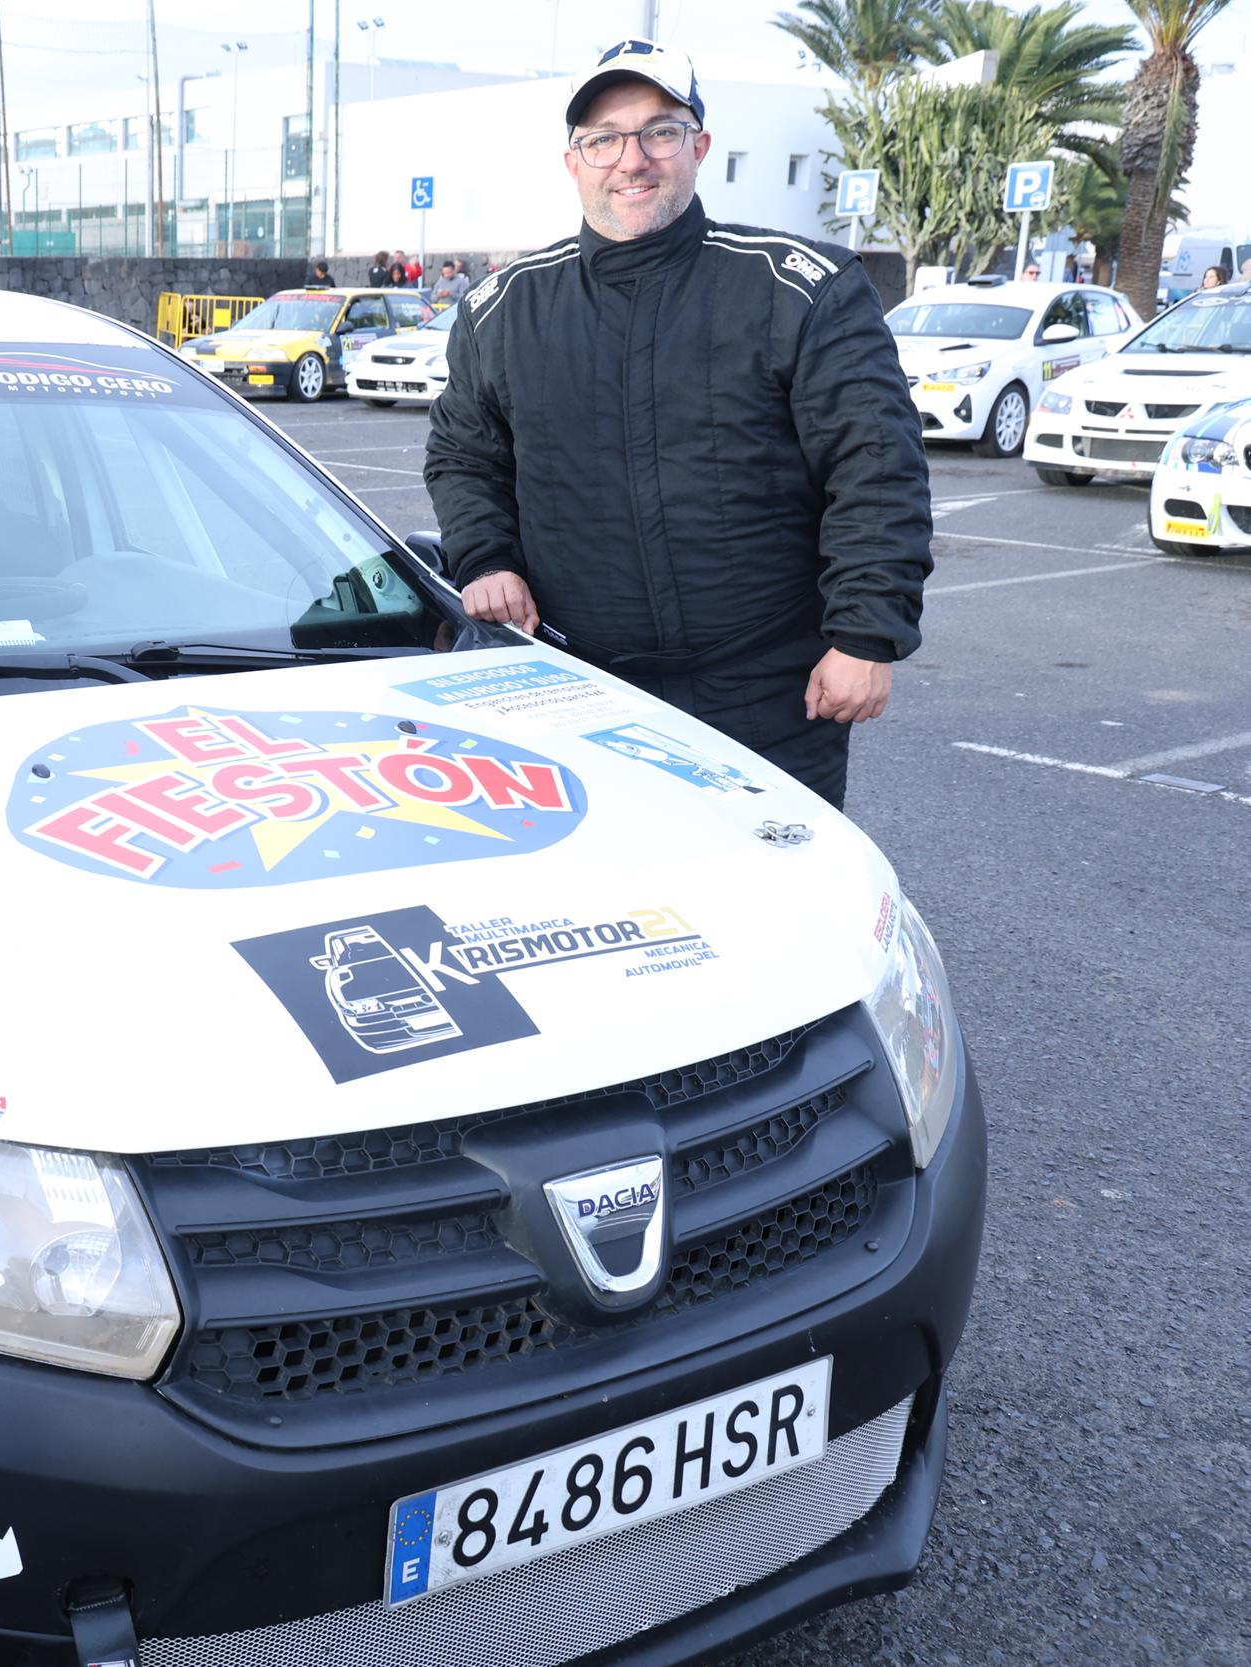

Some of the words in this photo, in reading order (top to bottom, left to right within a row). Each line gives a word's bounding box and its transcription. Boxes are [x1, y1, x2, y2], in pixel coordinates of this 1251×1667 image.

[846, 177, 870, 209] P
[1013, 171, 1042, 206] P
[785, 253, 823, 281] OMP
[8, 385, 157, 398] MOTORSPORT
[97, 375, 174, 394] CERO
[426, 664, 539, 688] SILENCIOSOS
[436, 680, 522, 703] MAURICIO
[140, 714, 316, 766] EL
[30, 737, 576, 876] FIESTÓN
[450, 917, 515, 936] TALLER
[464, 918, 575, 944] MULTIMARCA
[643, 941, 712, 958] MECANICA
[625, 957, 703, 978] AUTOMOVIL
[577, 1182, 659, 1218] DACIA
[452, 1434, 656, 1569] 8486
[672, 1382, 805, 1500] HSR
[402, 1558, 421, 1584] E
